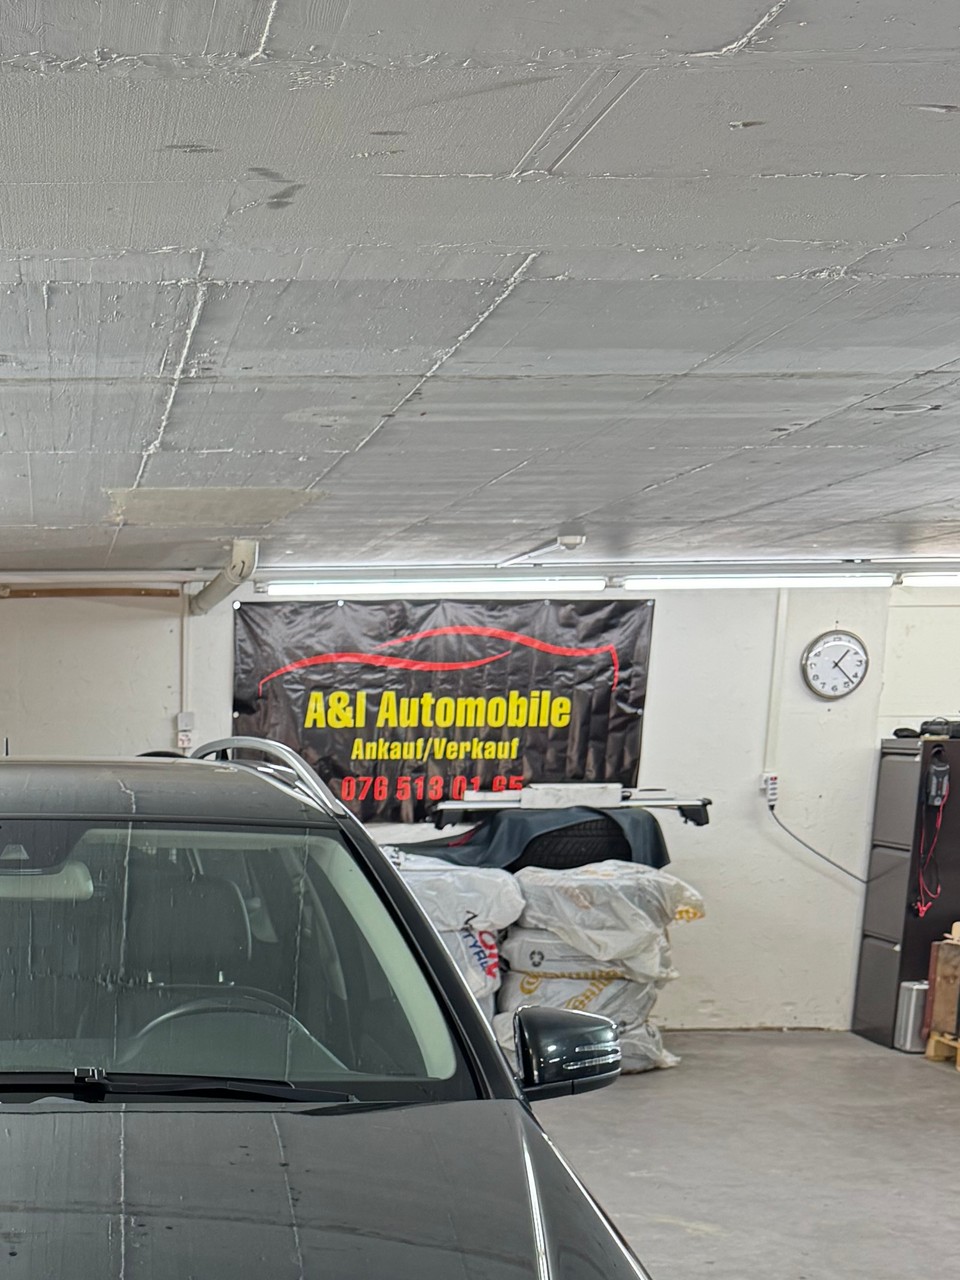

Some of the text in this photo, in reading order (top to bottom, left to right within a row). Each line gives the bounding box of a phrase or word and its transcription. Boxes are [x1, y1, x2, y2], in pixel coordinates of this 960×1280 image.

[303, 690, 572, 729] A&I Automobile
[350, 737, 520, 763] Ankauf/Verkauf
[341, 775, 389, 801] 076
[396, 775, 444, 801] 513
